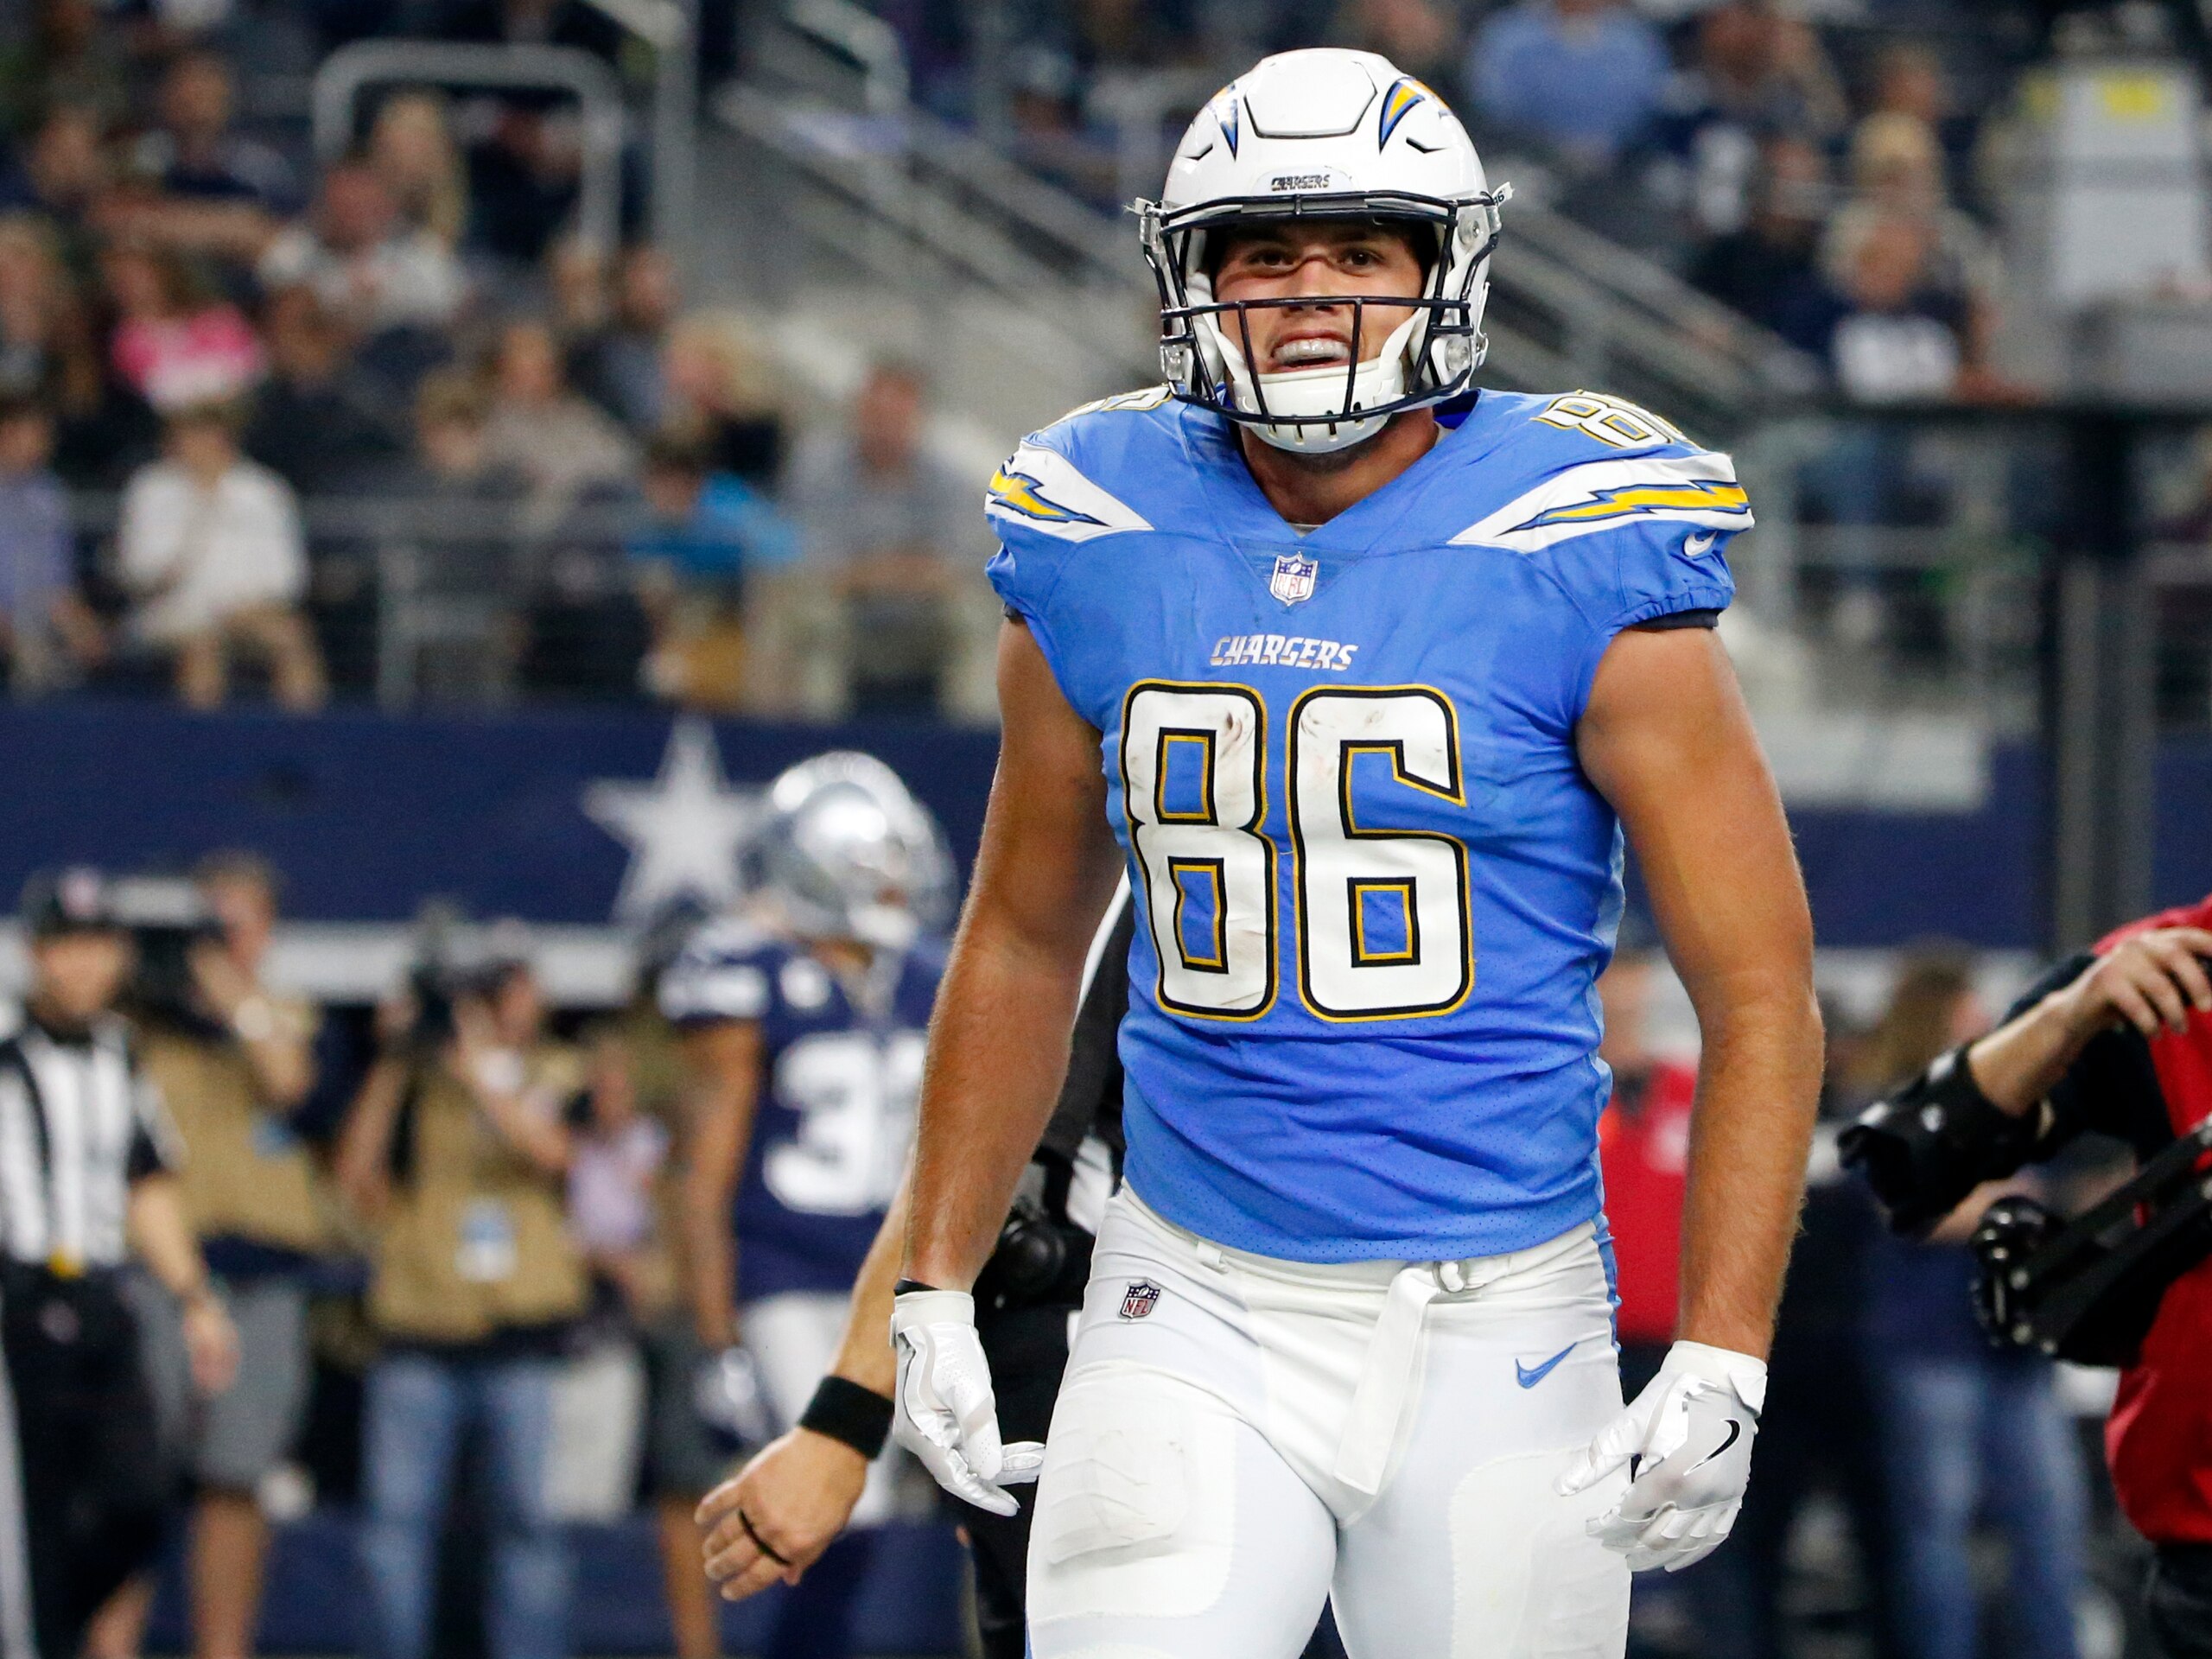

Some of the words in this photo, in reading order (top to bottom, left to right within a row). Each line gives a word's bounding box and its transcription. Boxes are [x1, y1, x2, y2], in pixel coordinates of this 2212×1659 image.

[1271, 175, 1330, 191] CHARGERS
[1529, 390, 1683, 450] 8
[1277, 575, 1303, 596] NFL
[1211, 634, 1358, 671] CHARGERS
[1120, 678, 1476, 1022] 86
[764, 1032, 927, 1212] 3
[1123, 1299, 1148, 1315] NFL
